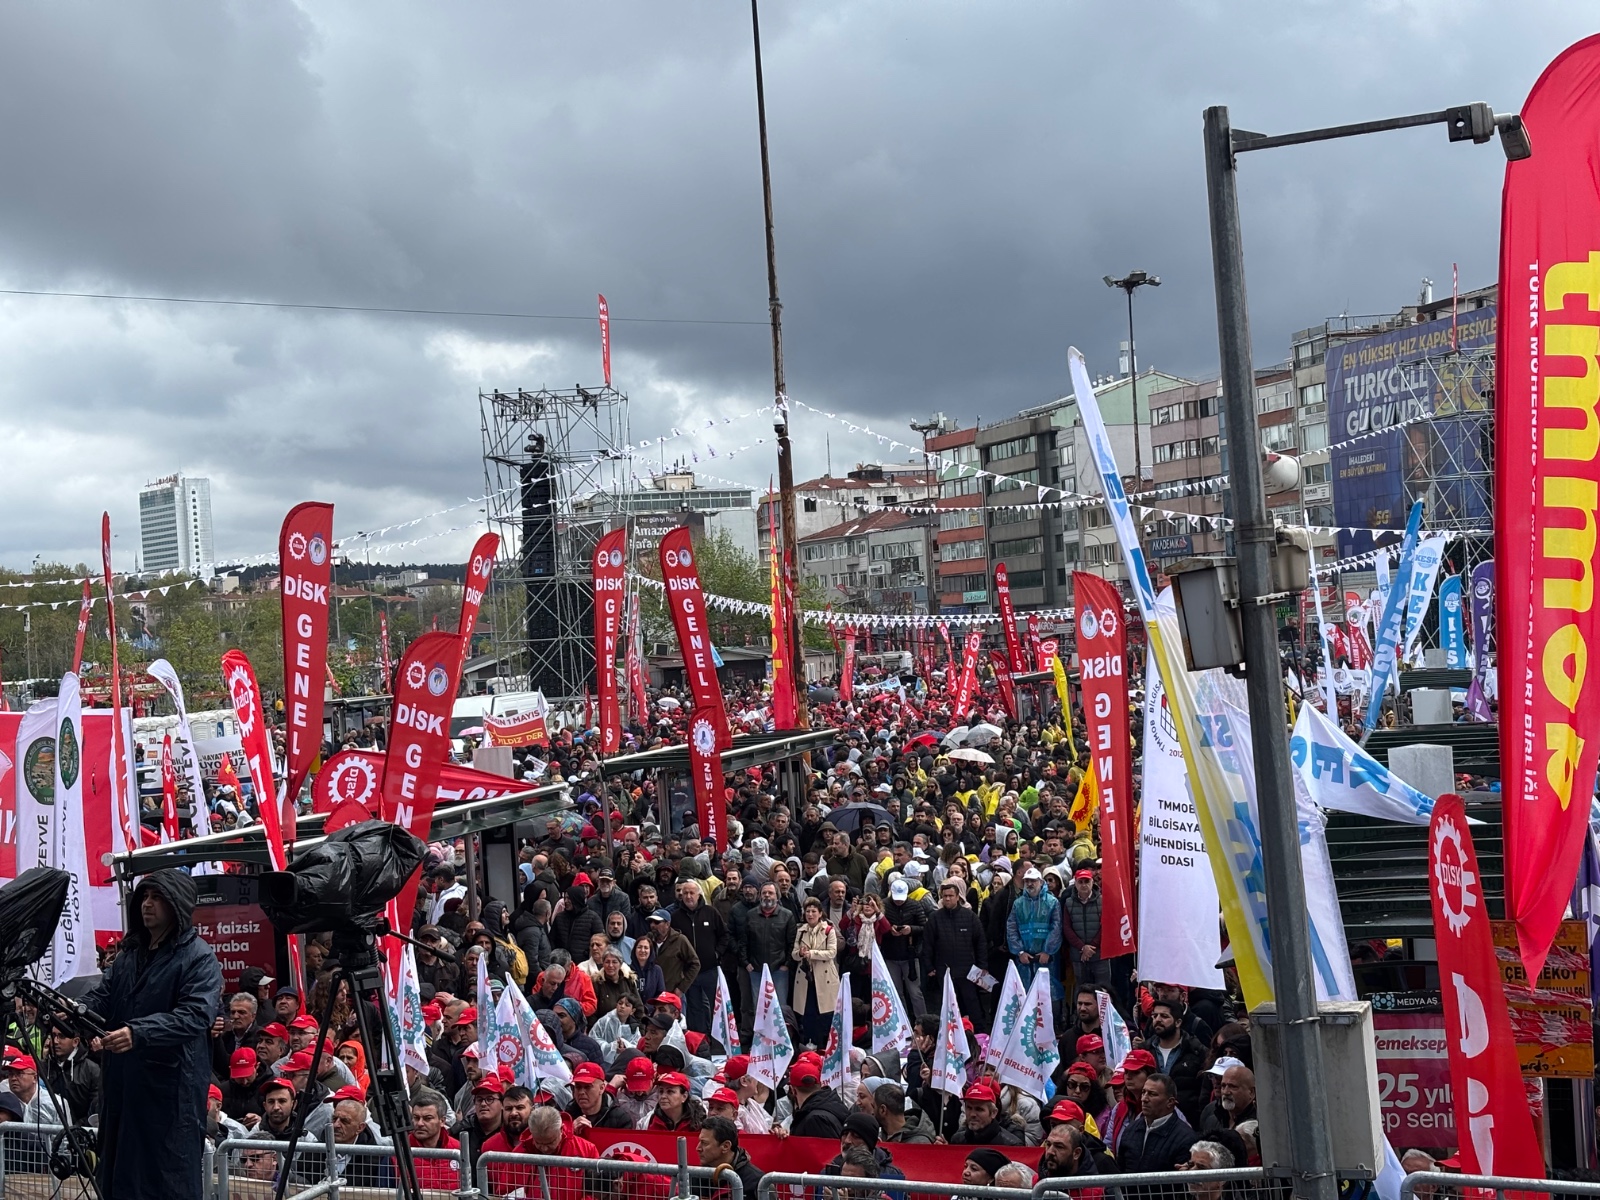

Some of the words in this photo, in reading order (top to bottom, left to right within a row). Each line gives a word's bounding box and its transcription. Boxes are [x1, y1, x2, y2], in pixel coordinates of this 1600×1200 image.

[1343, 354, 1356, 371] EN
[1359, 341, 1397, 367] YÜKSEK
[1399, 337, 1417, 355] HIZ
[1419, 316, 1496, 351] KAPASTESİYLE
[1414, 553, 1439, 565] KESK
[284, 574, 327, 605] DİSK
[595, 576, 623, 591] DİSK
[669, 576, 700, 591] DİSK
[396, 703, 445, 737] DİSK
[512, 709, 540, 724] MAYIS
[526, 731, 543, 742] DER
[703, 763, 713, 790] SEN
[37, 814, 49, 868] ZEYVE
[1160, 854, 1194, 868] ODASI
[217, 920, 260, 935] faizsiz
[1427, 997, 1438, 1006] AŞ
[500, 1045, 516, 1059] DİSK
[1004, 1057, 1036, 1078] BİRLEŞİK
[1378, 1072, 1419, 1109] 25
[1424, 1083, 1453, 1108] yıl
